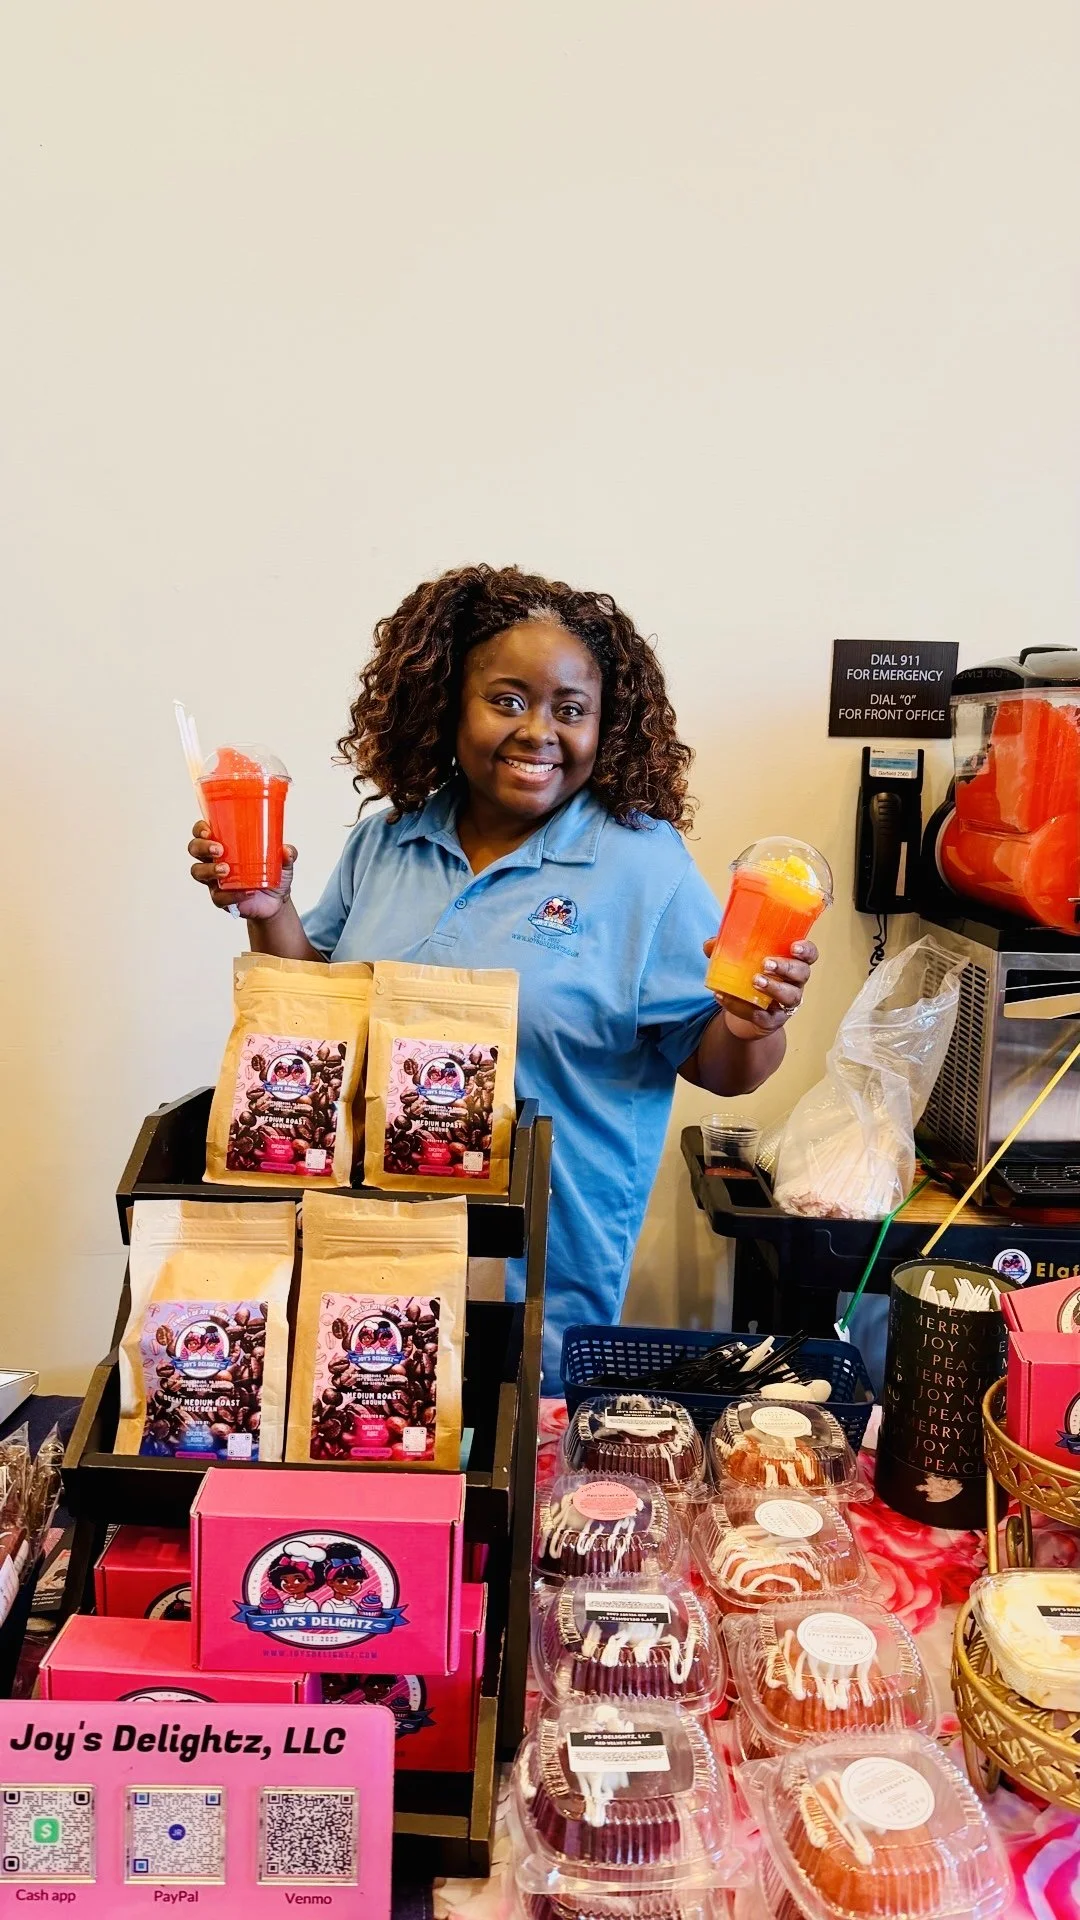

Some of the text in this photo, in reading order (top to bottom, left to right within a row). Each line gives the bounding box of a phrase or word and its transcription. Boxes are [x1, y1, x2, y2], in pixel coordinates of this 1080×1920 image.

[870, 654, 920, 666] DIAL 911
[846, 668, 944, 682] FOR EMERGENCY
[870, 693, 917, 706] DIAL “0”
[838, 708, 946, 721] FOR FRONT OFFICE
[260, 1116, 285, 1124] MEDIUM
[415, 1120, 462, 1129] MEDIUM ROAST
[922, 1333, 959, 1353] JOY
[346, 1392, 401, 1400] MEDIUM ROAST
[919, 1385, 954, 1404] JOY
[184, 1398, 213, 1407] MEDIUM
[214, 1399, 240, 1407] ROAST
[928, 1405, 980, 1424] PEAC
[915, 1436, 950, 1455] JOY
[268, 1615, 374, 1631] JOY'S DELIGHTZ
[301, 1635, 317, 1643] EST.
[10, 1720, 346, 1763] Joy's Delightz, LLC
[15, 1888, 76, 1904] Cash app
[154, 1890, 199, 1904] PayPal
[285, 1892, 333, 1905] Venmo
